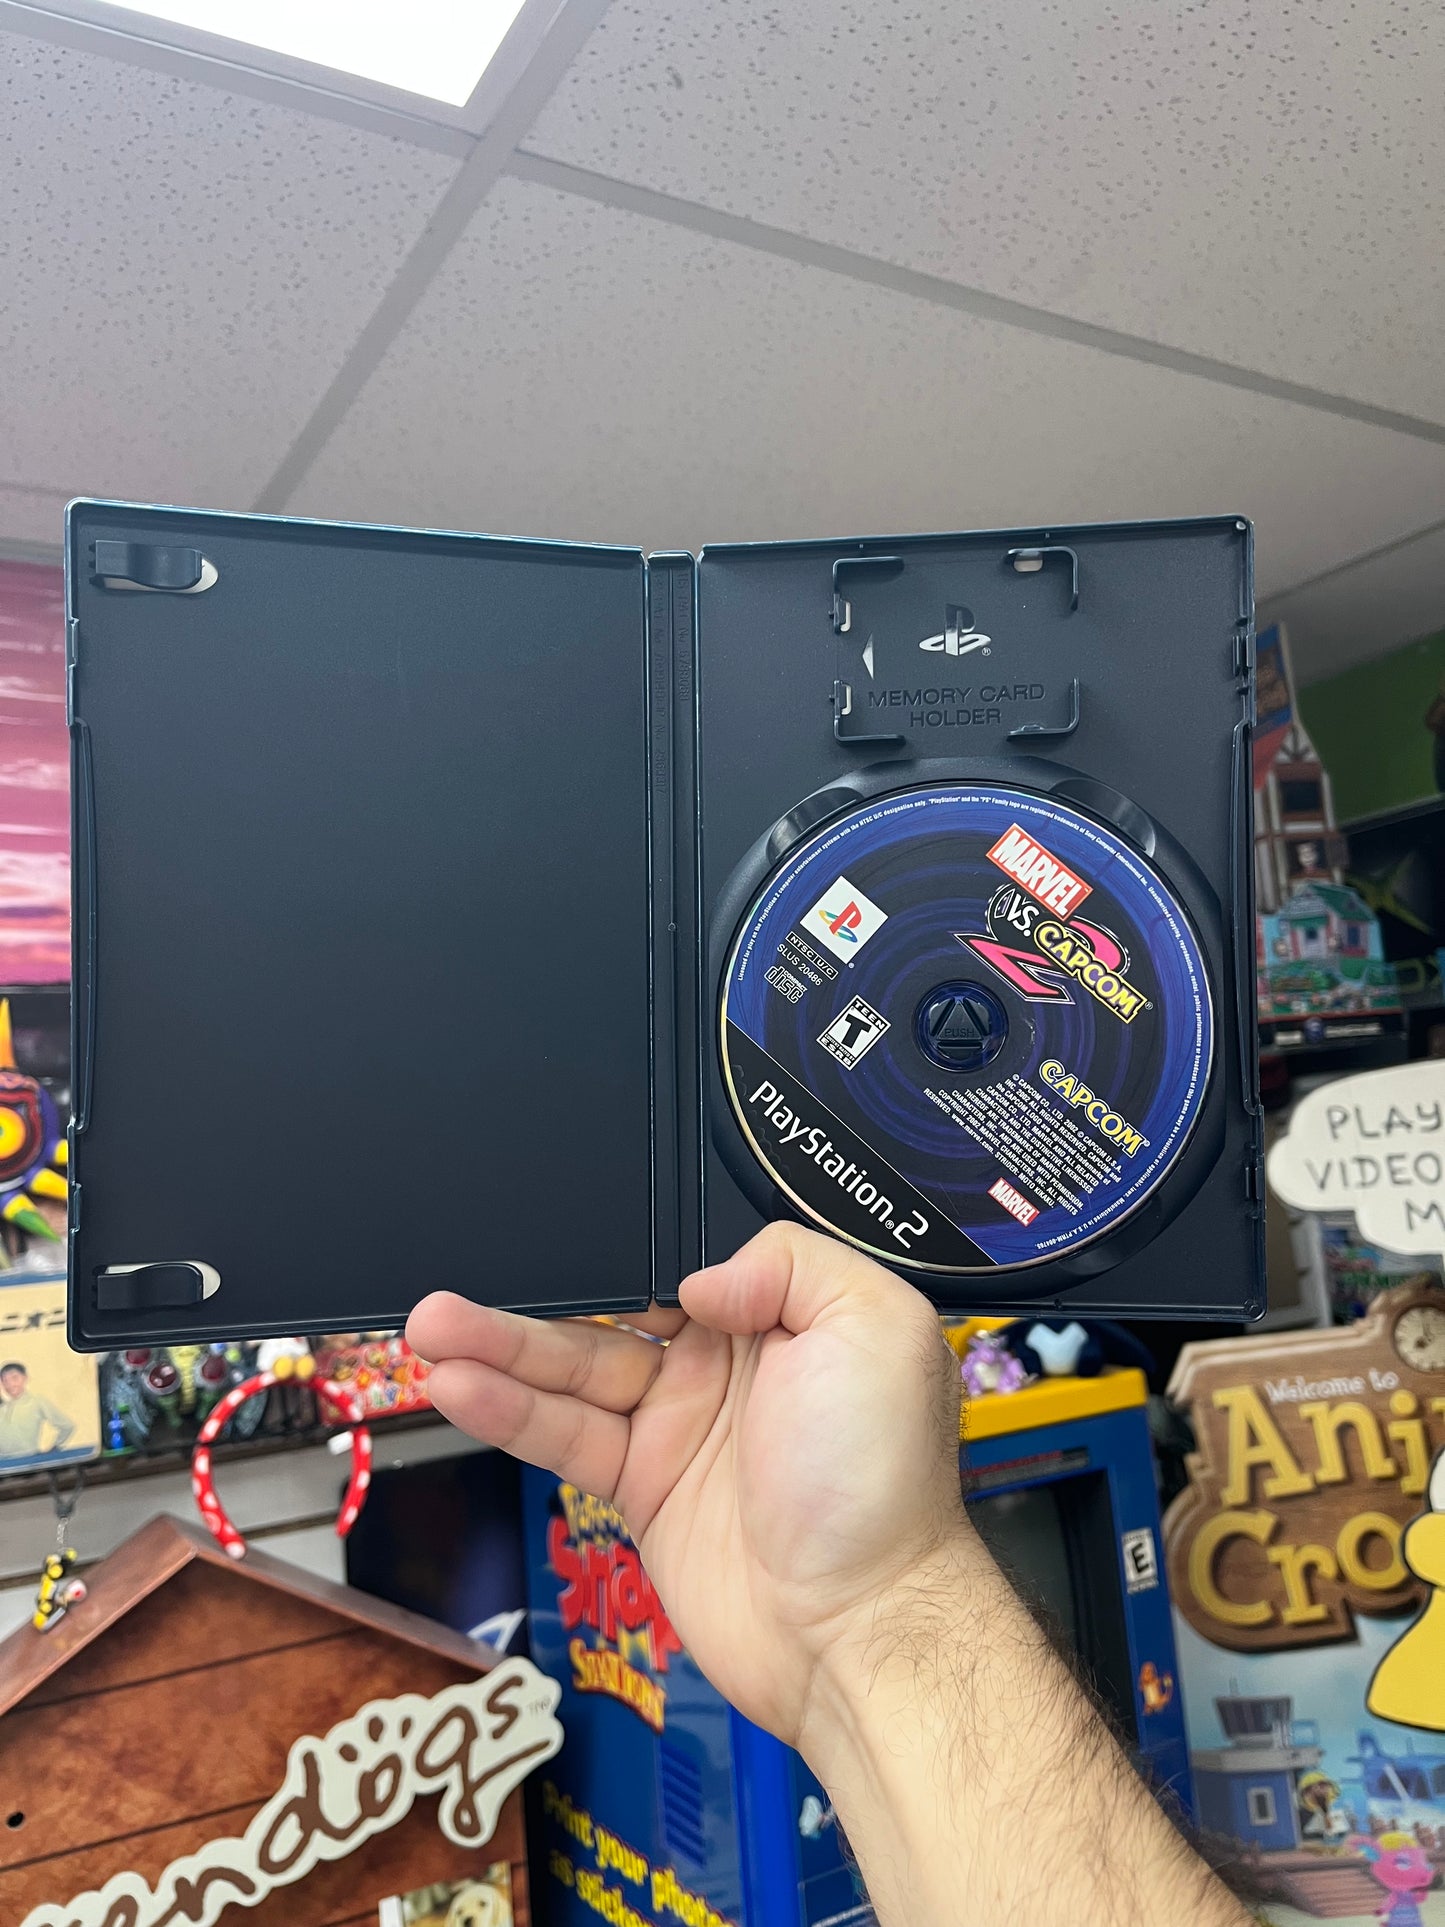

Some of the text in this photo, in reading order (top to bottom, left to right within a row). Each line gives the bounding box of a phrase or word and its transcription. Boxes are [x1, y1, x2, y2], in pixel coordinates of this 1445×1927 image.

[868, 683, 1046, 708] MEMORY CARD
[910, 708, 1002, 728] HOLDER
[991, 830, 1083, 917] MARVEL
[1007, 893, 1040, 937] VS.
[777, 943, 823, 986] SLUS 20486
[790, 935, 815, 959] NTSC
[783, 970, 808, 992] COMPACT
[844, 1013, 872, 1049] T
[854, 999, 887, 1030] TEEN
[944, 1028, 975, 1038] PUSH
[821, 1036, 852, 1067] ESRB
[963, 1089, 1062, 1178] THEREOF ARE TRADEMARKS OF MARVEL
[975, 1087, 1094, 1194] CHARACTERS AND THE DISTINCTIVE LIKENESSES
[986, 1085, 1009, 1107] CAPCOM
[1019, 1114, 1033, 1128] LTD.
[1031, 1125, 1054, 1147] MARVEL
[1052, 1144, 1066, 1157] AND
[1064, 1154, 1076, 1166] ALL
[1074, 1164, 1099, 1186] RELATED
[995, 1082, 1110, 1185] the CAPCOM LOGO are registered trademarks of
[1004, 1078, 1017, 1091] INC.
[1015, 1088, 1030, 1102] 2002
[1028, 1099, 1041, 1111] ALL
[1038, 1108, 1060, 1128] RIGHTS
[1086, 1151, 1111, 1173] CAPCOM
[1109, 1171, 1121, 1182] and
[1017, 1078, 1042, 1100] CAPCOM
[1051, 1108, 1065, 1121] LTD.
[1063, 1118, 1078, 1133] 2002
[1082, 1135, 1107, 1158] CAPCOM
[1104, 1155, 1123, 1172] U.S.A.
[1327, 1101, 1442, 1140] PLAY
[937, 1089, 968, 1117] COPYRIGHT
[966, 1114, 980, 1128] 2002
[978, 1125, 1002, 1147] MARVEL
[1034, 1176, 1048, 1188] INC.
[1046, 1186, 1058, 1198] ALL
[1056, 1195, 1078, 1215] RIGHTS
[998, 1132, 1012, 1145] AND
[1010, 1142, 1023, 1154] ARE
[1021, 1152, 1037, 1167] USED
[1035, 1164, 1051, 1180] WITH
[1304, 1152, 1442, 1191] VIDEO
[1017, 1172, 1035, 1189] MOTO
[988, 1179, 1037, 1227] MARVEL
[892, 1209, 929, 1249] 2
[1265, 1366, 1400, 1403] Welcome to
[1131, 1542, 1150, 1574] E
[546, 1515, 684, 1674] Snap
[543, 1780, 595, 1849] Print
[594, 1823, 650, 1887] your
